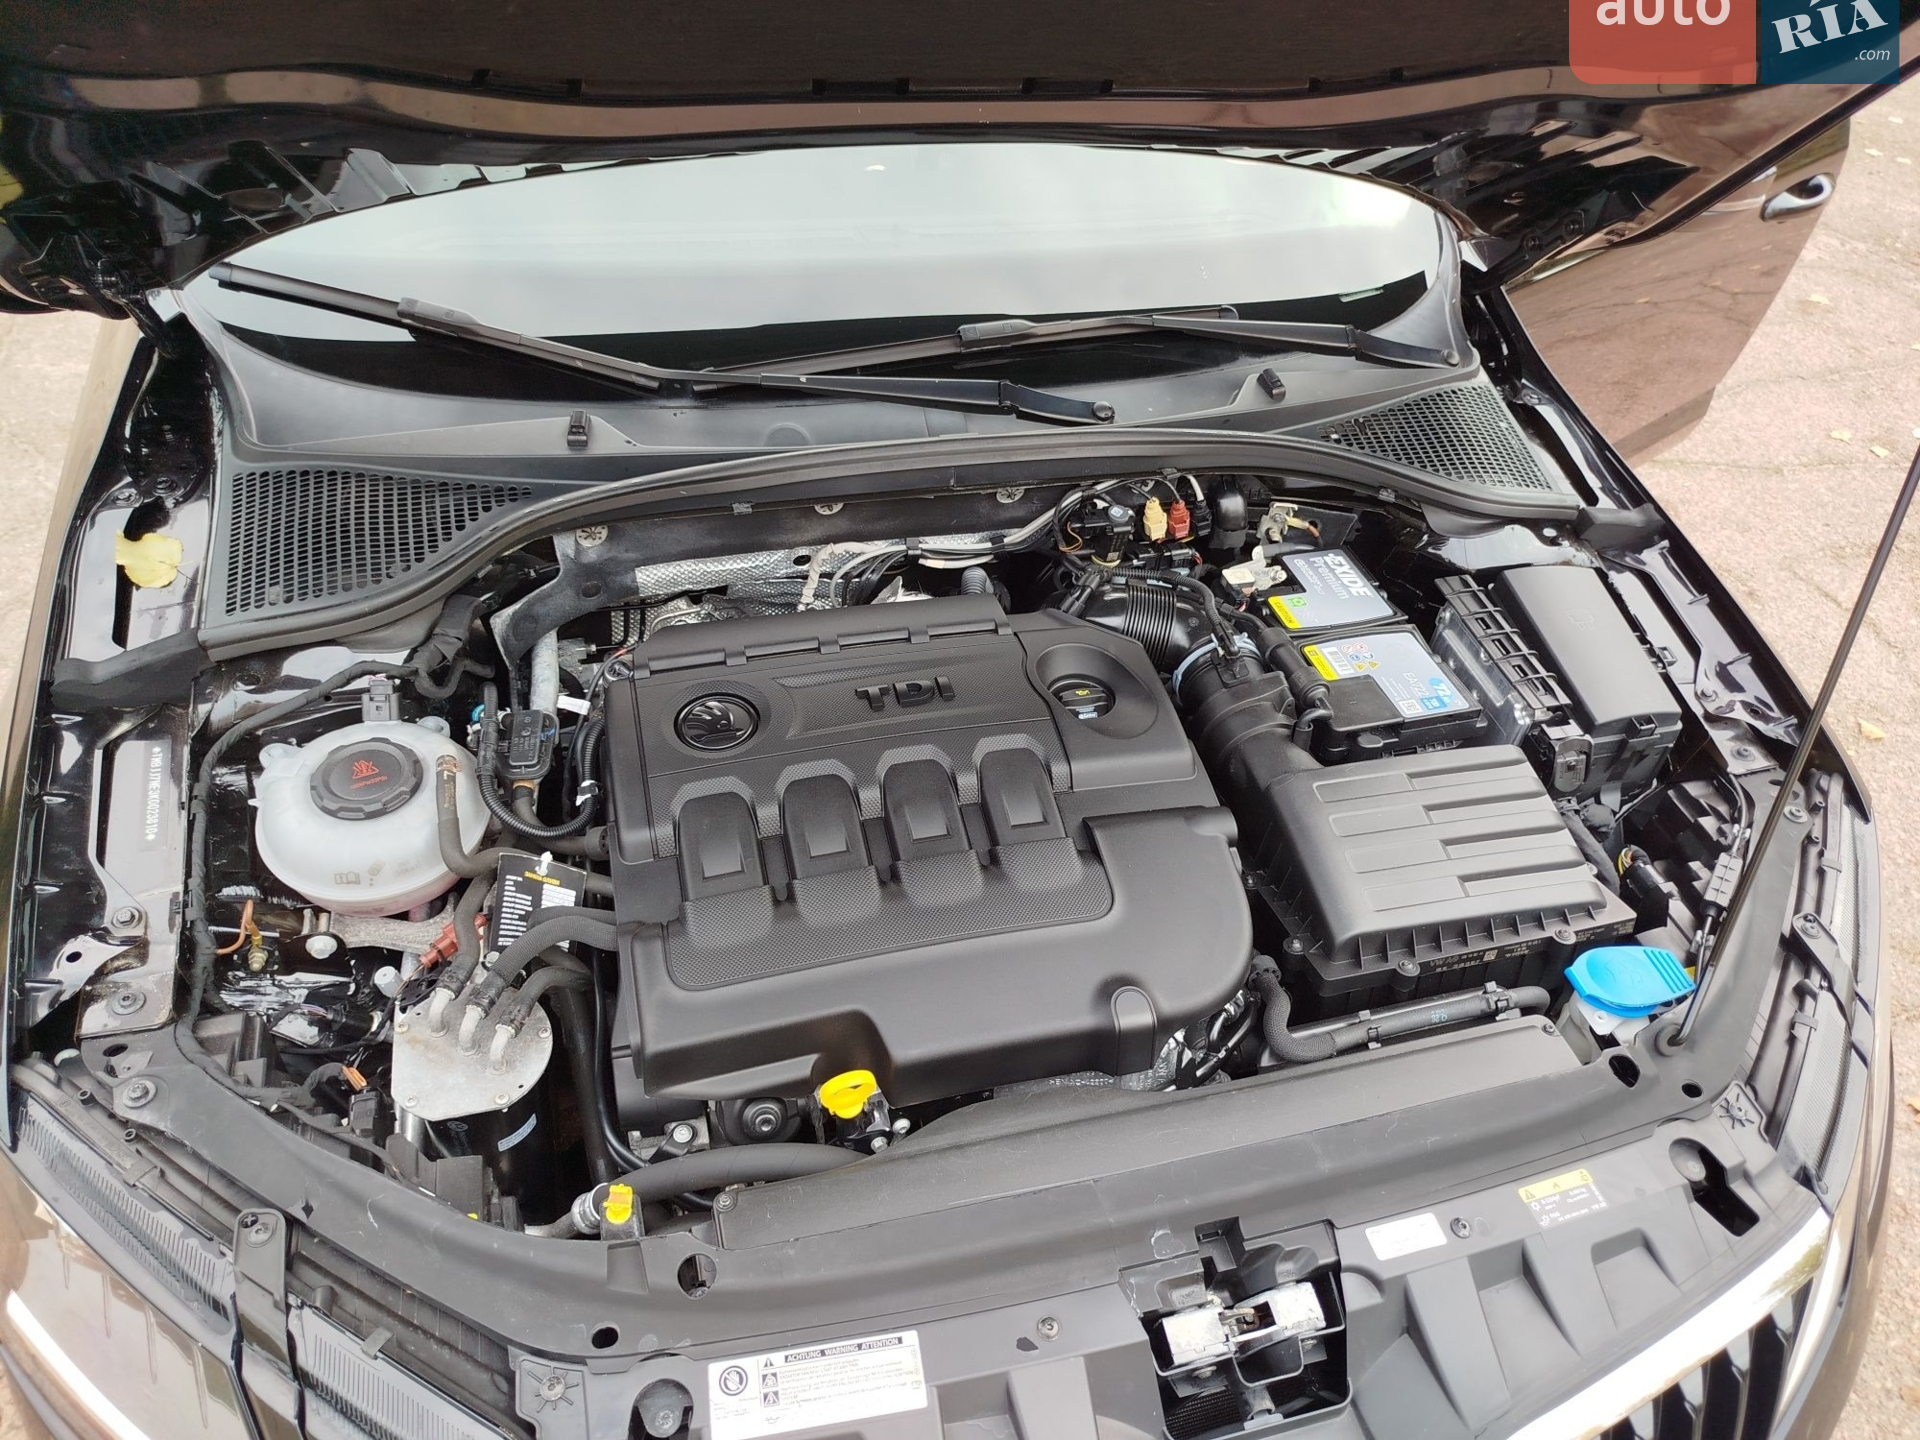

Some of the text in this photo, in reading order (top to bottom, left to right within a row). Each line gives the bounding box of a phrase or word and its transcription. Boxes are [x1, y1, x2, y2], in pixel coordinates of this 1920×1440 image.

[1309, 557, 1349, 599] Premium
[1323, 553, 1372, 597] EXIDE
[854, 676, 956, 711] TDI
[1403, 672, 1430, 696] EA722
[787, 1337, 898, 1362] ACHTUNG WARNING ATTENTION
